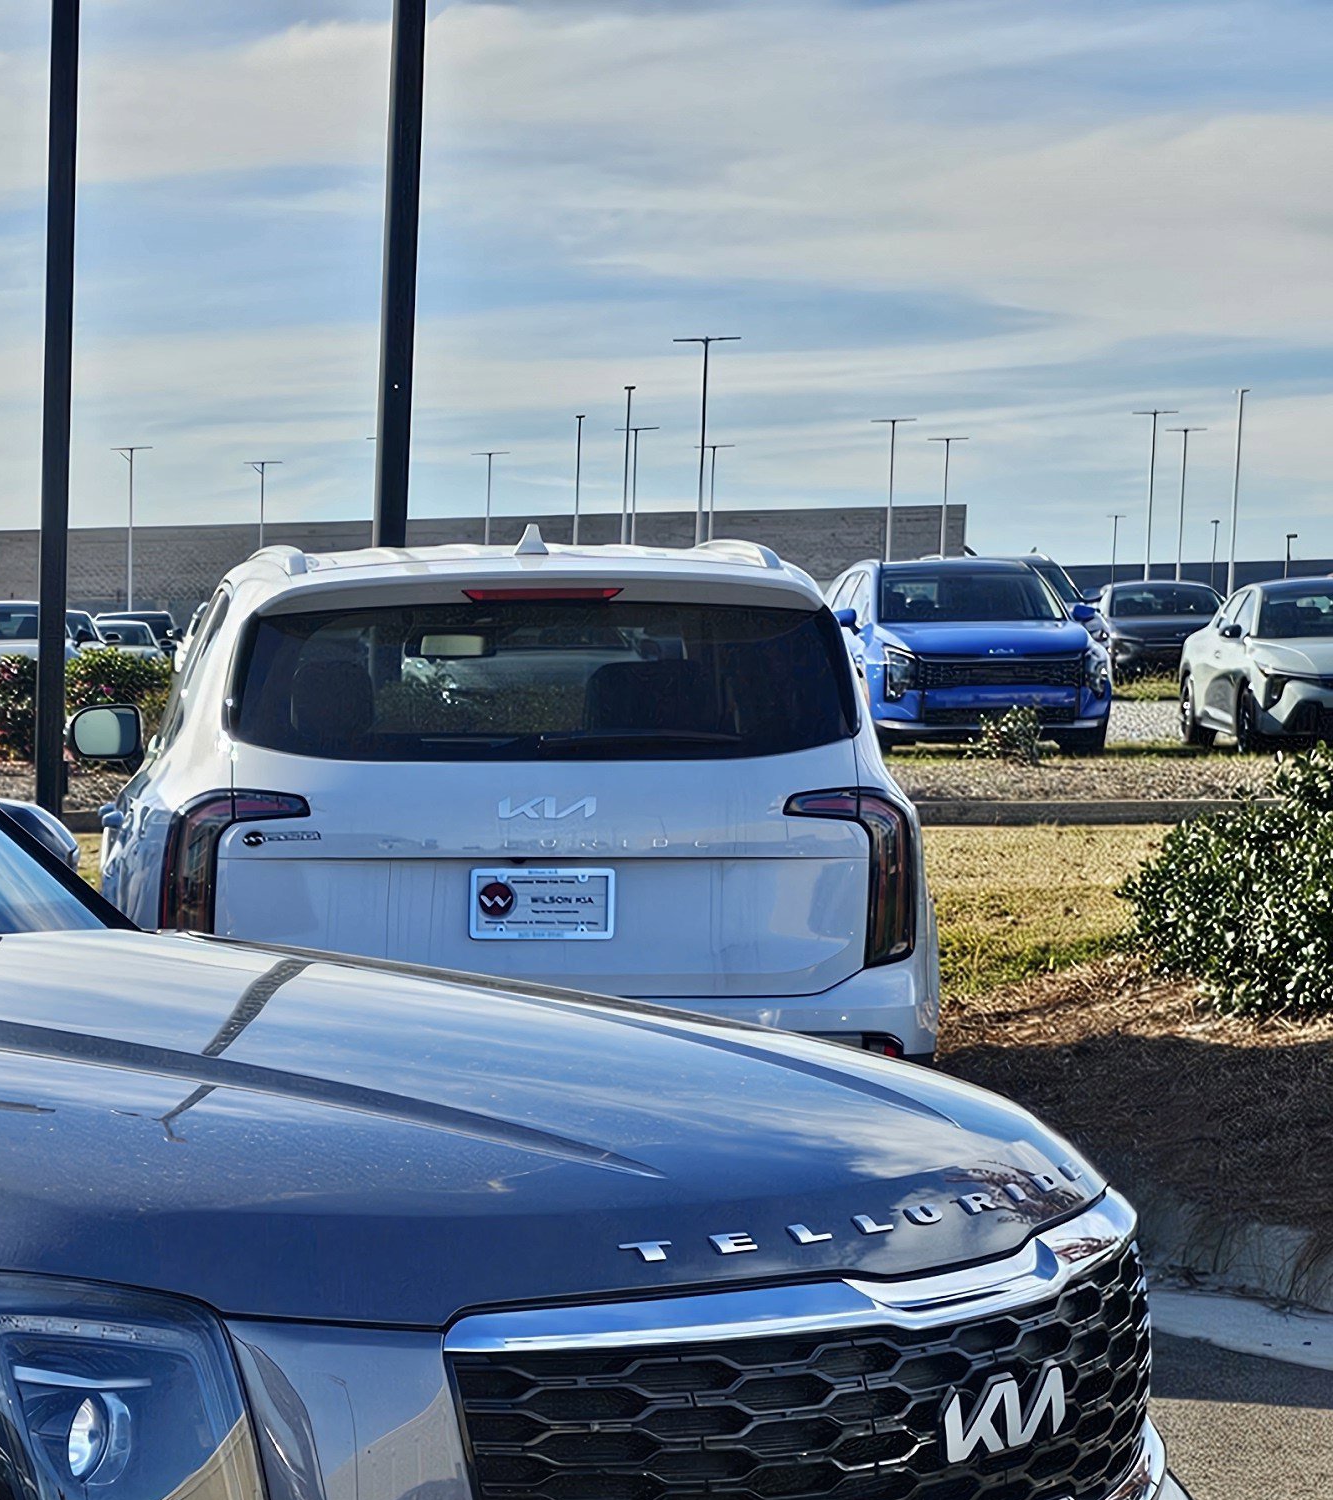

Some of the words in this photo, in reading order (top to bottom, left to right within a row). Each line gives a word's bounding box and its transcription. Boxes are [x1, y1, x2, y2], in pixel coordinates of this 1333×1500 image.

[498, 796, 597, 819] KIA
[618, 1160, 1083, 1262] TELLURIDE
[942, 1359, 1065, 1464] KIA
